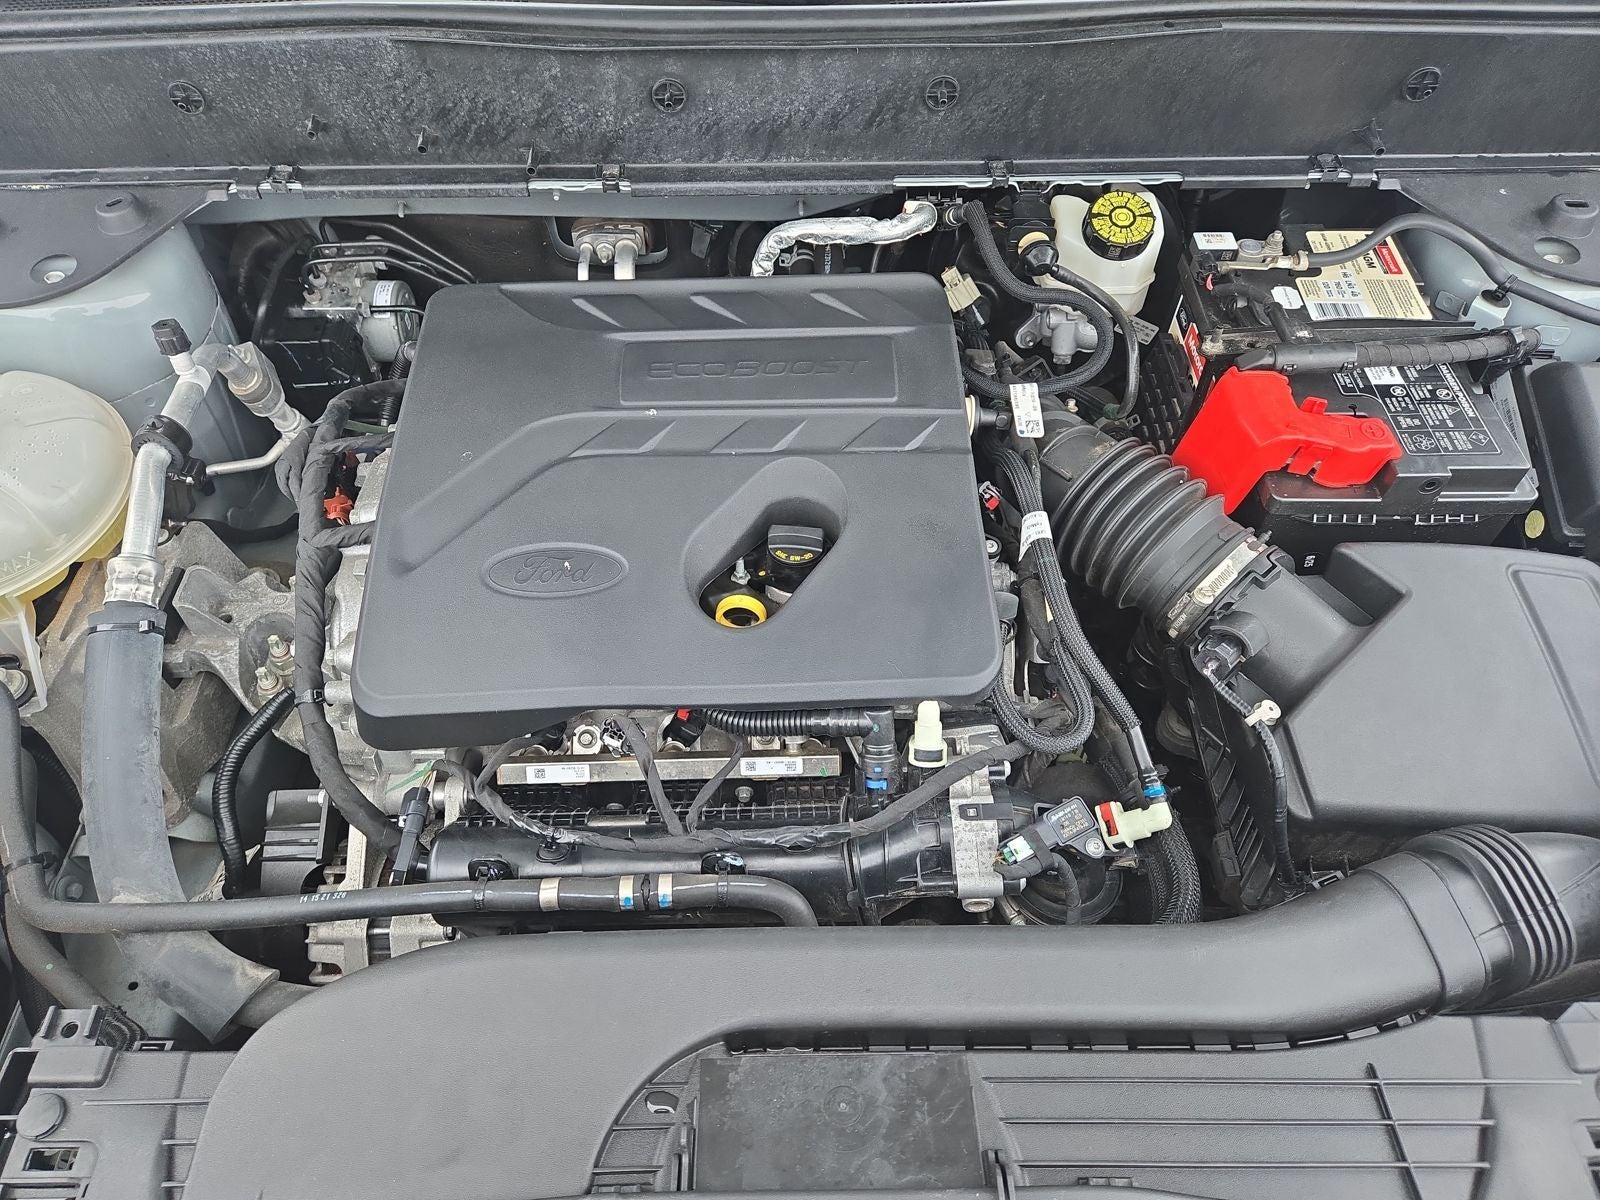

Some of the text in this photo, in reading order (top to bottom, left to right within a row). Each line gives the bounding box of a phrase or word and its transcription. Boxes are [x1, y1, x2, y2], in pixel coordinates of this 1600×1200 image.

[648, 360, 869, 380] ECOBOOST
[1438, 364, 1476, 417] DANGER/POISON
[514, 555, 600, 586] Ford
